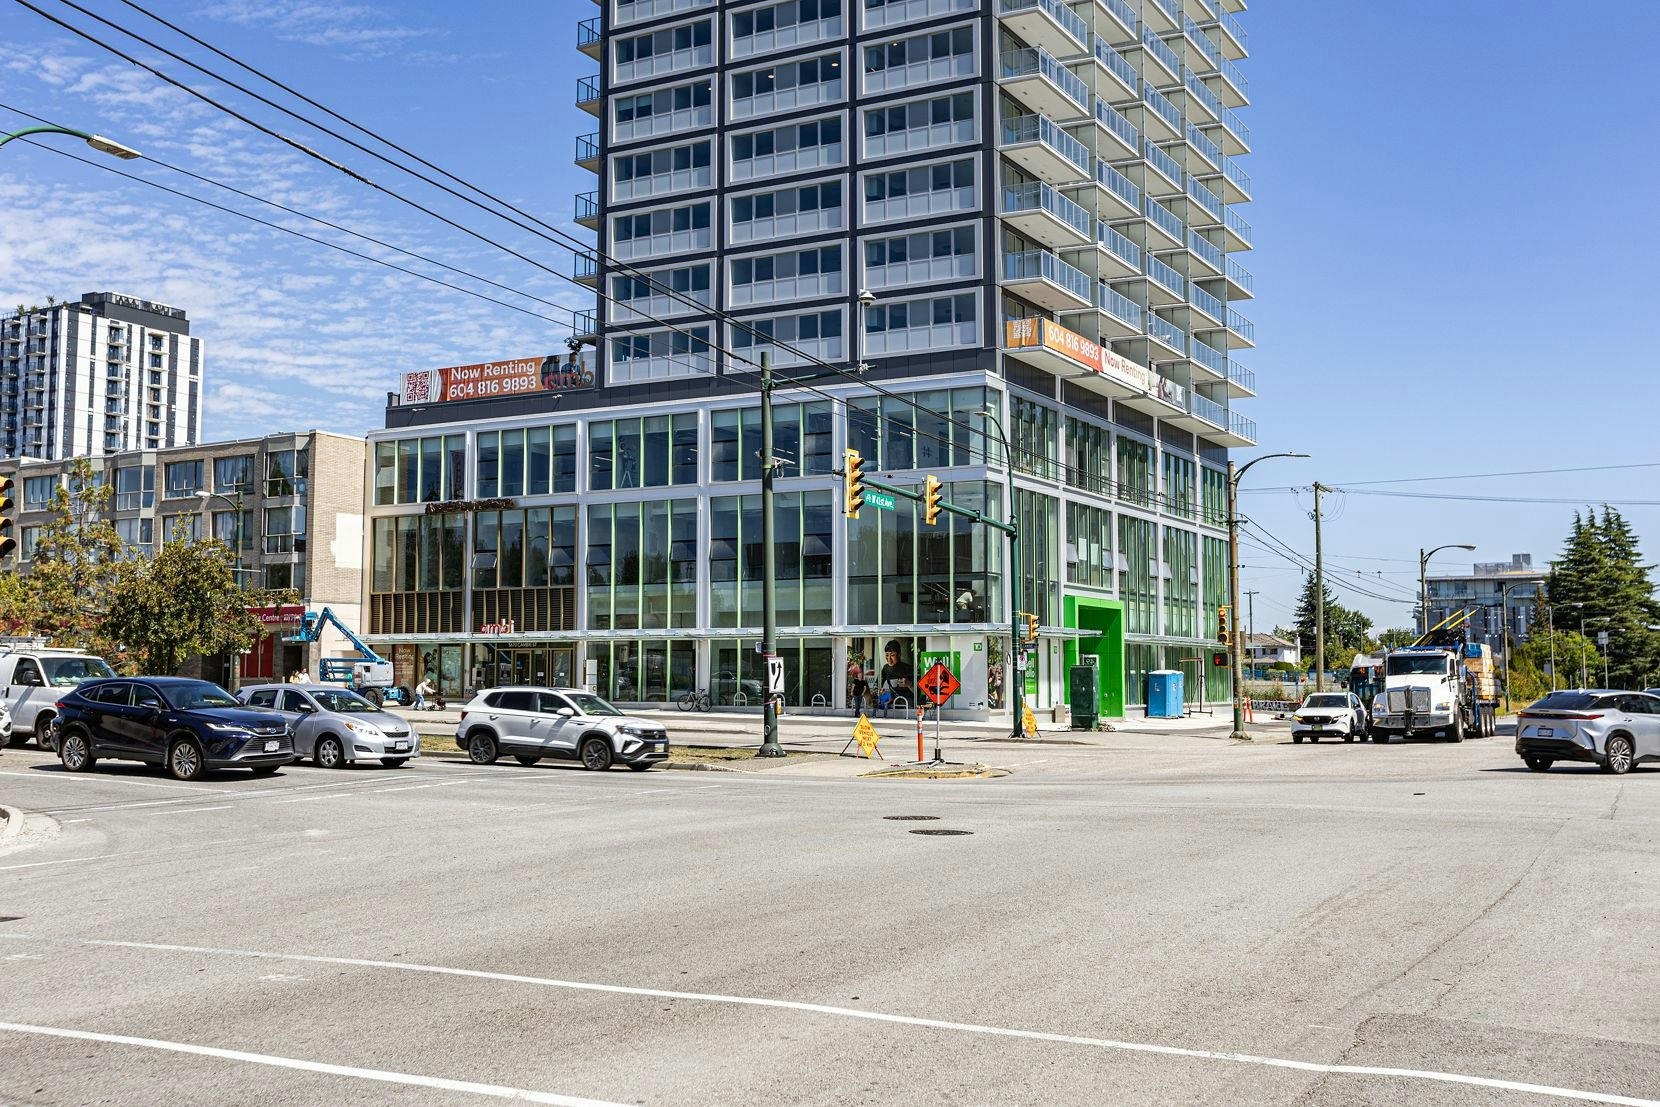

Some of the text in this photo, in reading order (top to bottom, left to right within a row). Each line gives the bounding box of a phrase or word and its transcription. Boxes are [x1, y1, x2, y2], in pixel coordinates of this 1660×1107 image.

[1048, 326, 1099, 361] 604 816 9893
[451, 360, 535, 381] Now Renting
[1104, 350, 1145, 384] Now Renting
[449, 383, 475, 398] 604
[477, 380, 499, 395] 816
[503, 376, 536, 392] 9893
[262, 613, 280, 622] Centre
[480, 618, 515, 634] ambi
